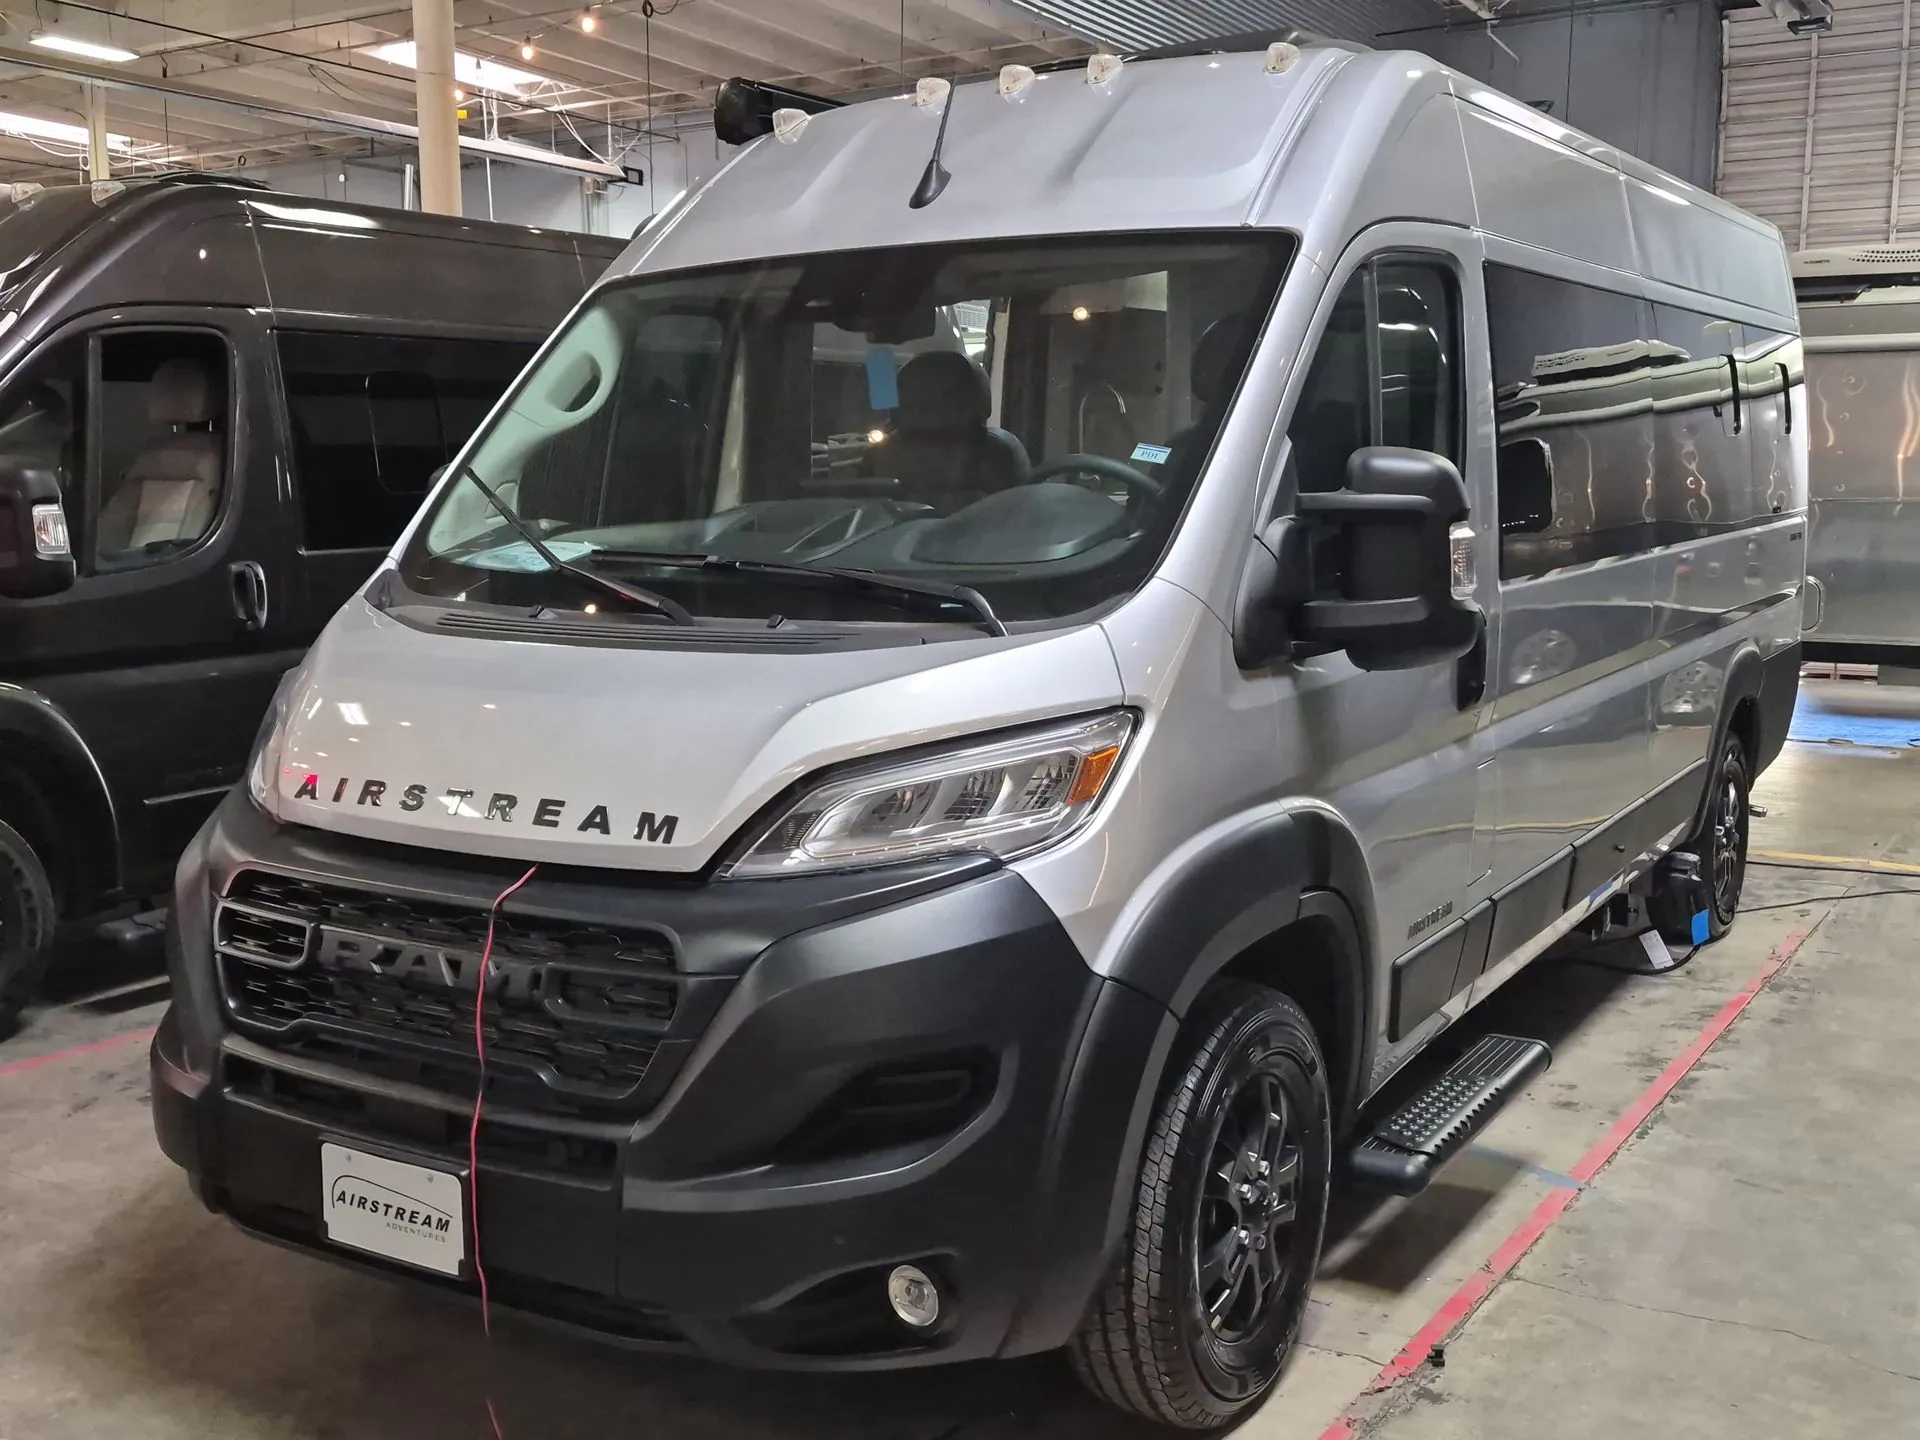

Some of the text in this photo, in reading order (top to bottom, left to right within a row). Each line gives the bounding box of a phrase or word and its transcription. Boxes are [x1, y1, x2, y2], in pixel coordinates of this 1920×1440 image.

[1141, 450, 1159, 459] PDI
[294, 773, 680, 845] AIRSTREAM
[318, 923, 536, 1002] RAM
[336, 1190, 451, 1233] AIRSTREAM
[386, 1221, 447, 1243] ADVENTURES
